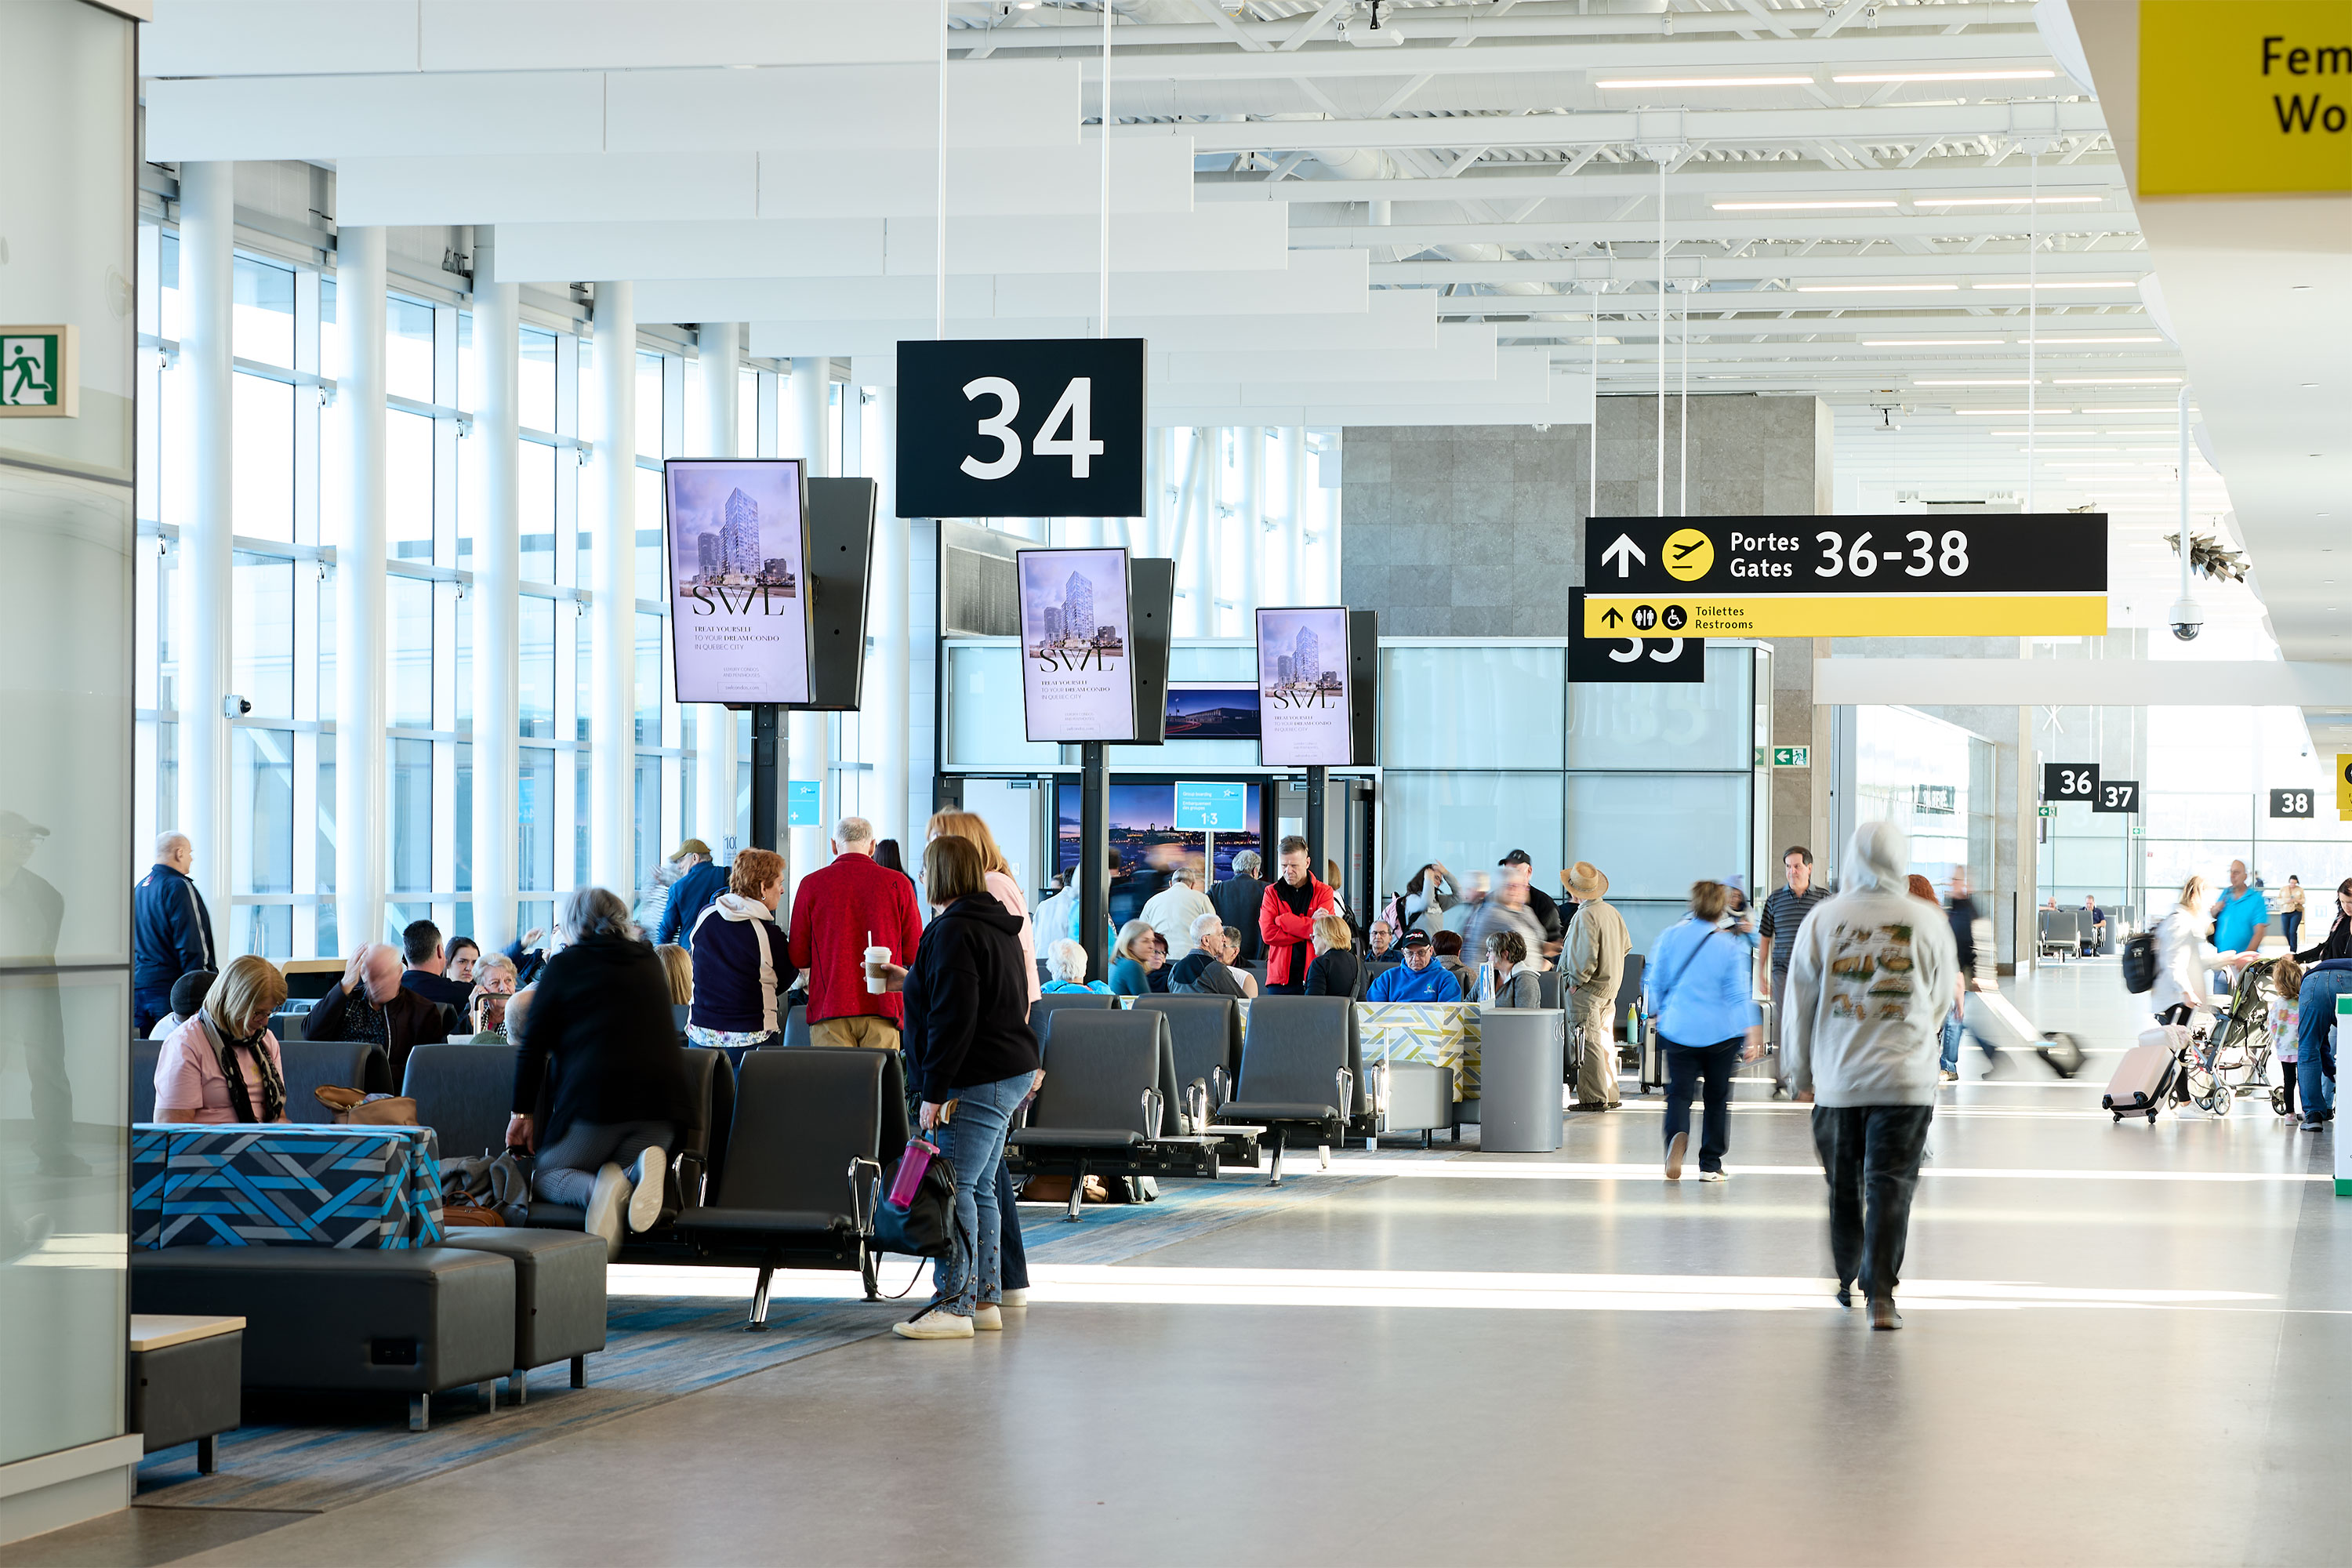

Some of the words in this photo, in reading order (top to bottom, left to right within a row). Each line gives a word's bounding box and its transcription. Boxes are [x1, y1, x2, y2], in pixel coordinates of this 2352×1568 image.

[2262, 36, 2352, 76] Fem
[960, 376, 1105, 481] 34
[1730, 532, 1800, 551] Portes
[1814, 529, 1969, 578] 36-38
[1730, 557, 1793, 578] Gates
[692, 585, 785, 616] SWL
[1695, 606, 1744, 616] Toilettes
[1695, 619, 1754, 630] Restrooms
[1040, 648, 1114, 673] SWL
[1273, 689, 1335, 710] SWL
[2060, 770, 2092, 795] 36
[2104, 786, 2133, 808] 37
[2281, 793, 2309, 814] 38
